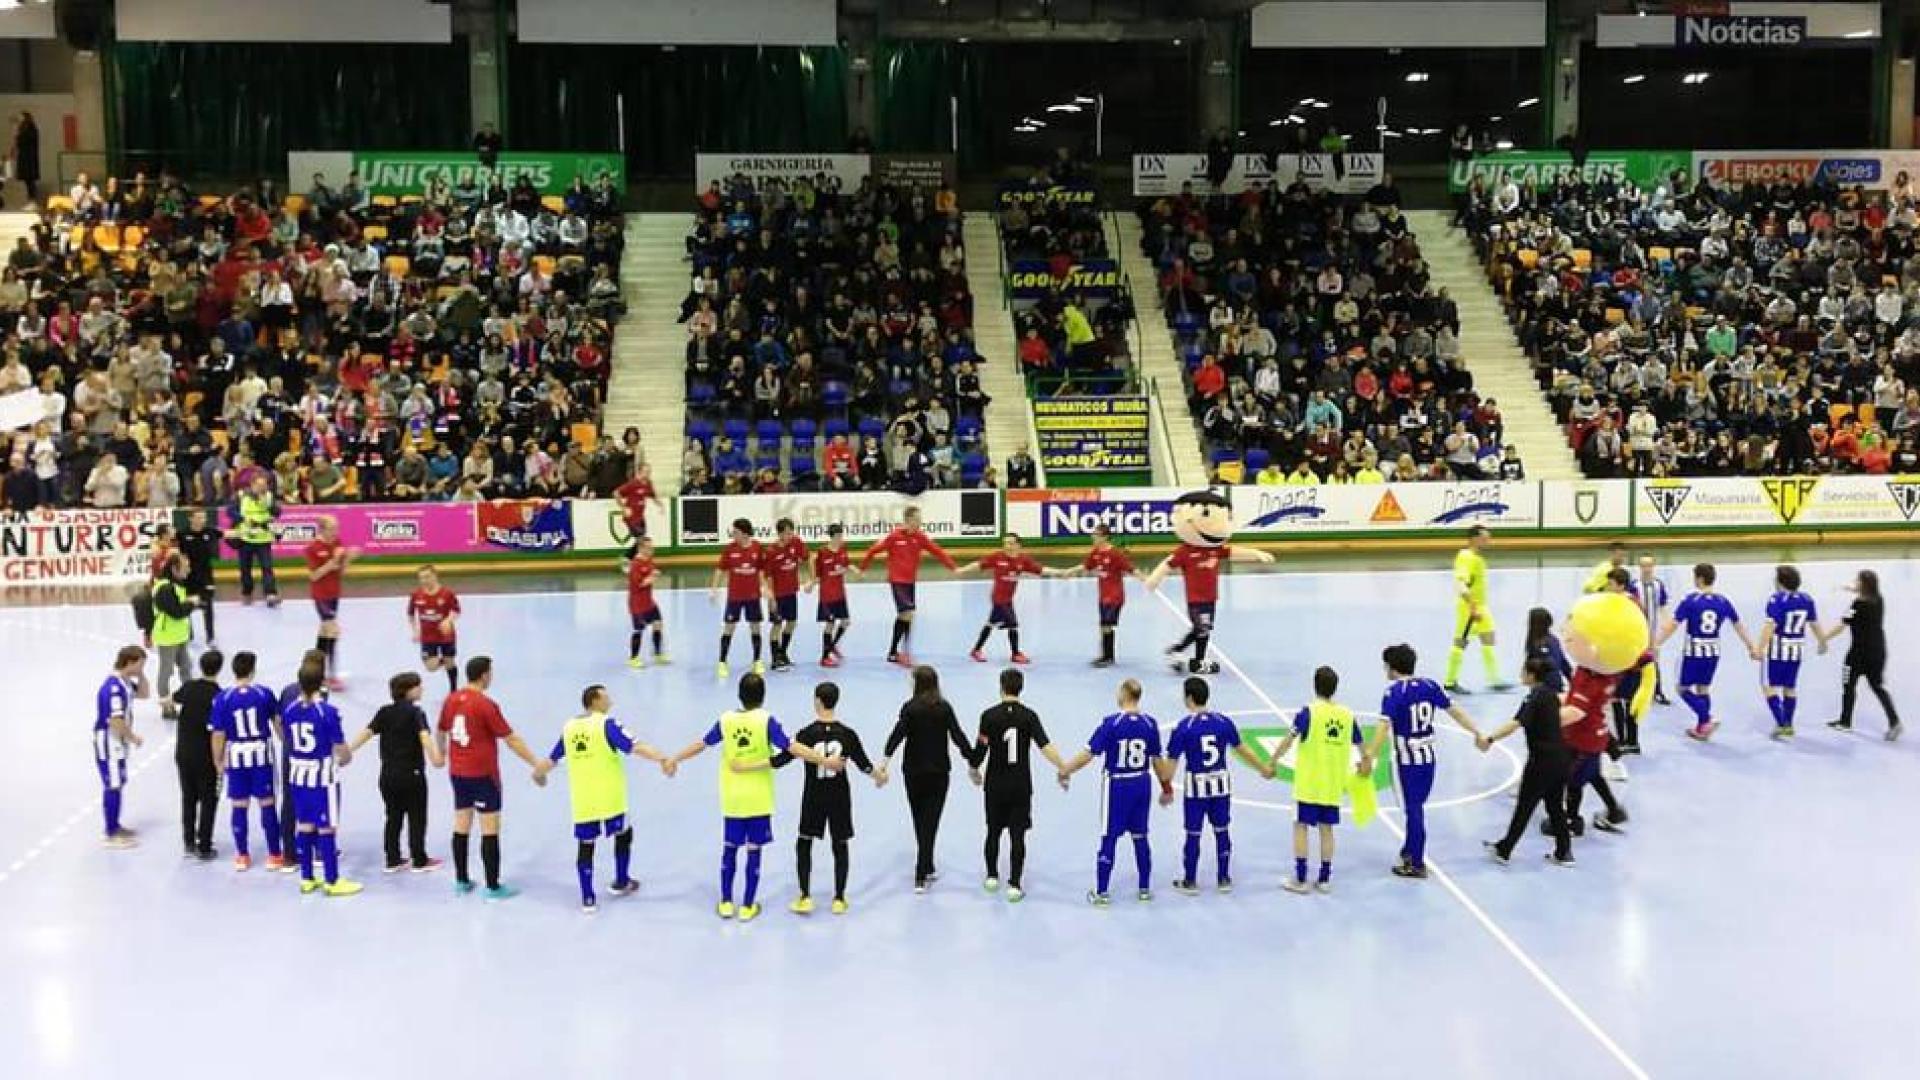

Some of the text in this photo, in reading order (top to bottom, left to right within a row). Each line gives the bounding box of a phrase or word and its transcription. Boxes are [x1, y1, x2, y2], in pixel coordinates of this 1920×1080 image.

[1685, 17, 1800, 44] Noticias
[359, 160, 552, 188] UNICARRERS
[1453, 160, 1627, 185] UNICARRERS
[1013, 265, 1116, 291] GOOYEAR
[1044, 450, 1146, 468] GOODYEAR
[1049, 503, 1173, 535] Noticia
[1701, 611, 1717, 634] 8
[1784, 611, 1808, 634] 17
[233, 707, 260, 737] 11
[451, 714, 471, 747] 4
[1410, 702, 1434, 733] 19
[290, 722, 317, 753] 15
[1003, 727, 1018, 763] 1
[1201, 734, 1219, 766] 5
[1117, 739, 1147, 768] 18
